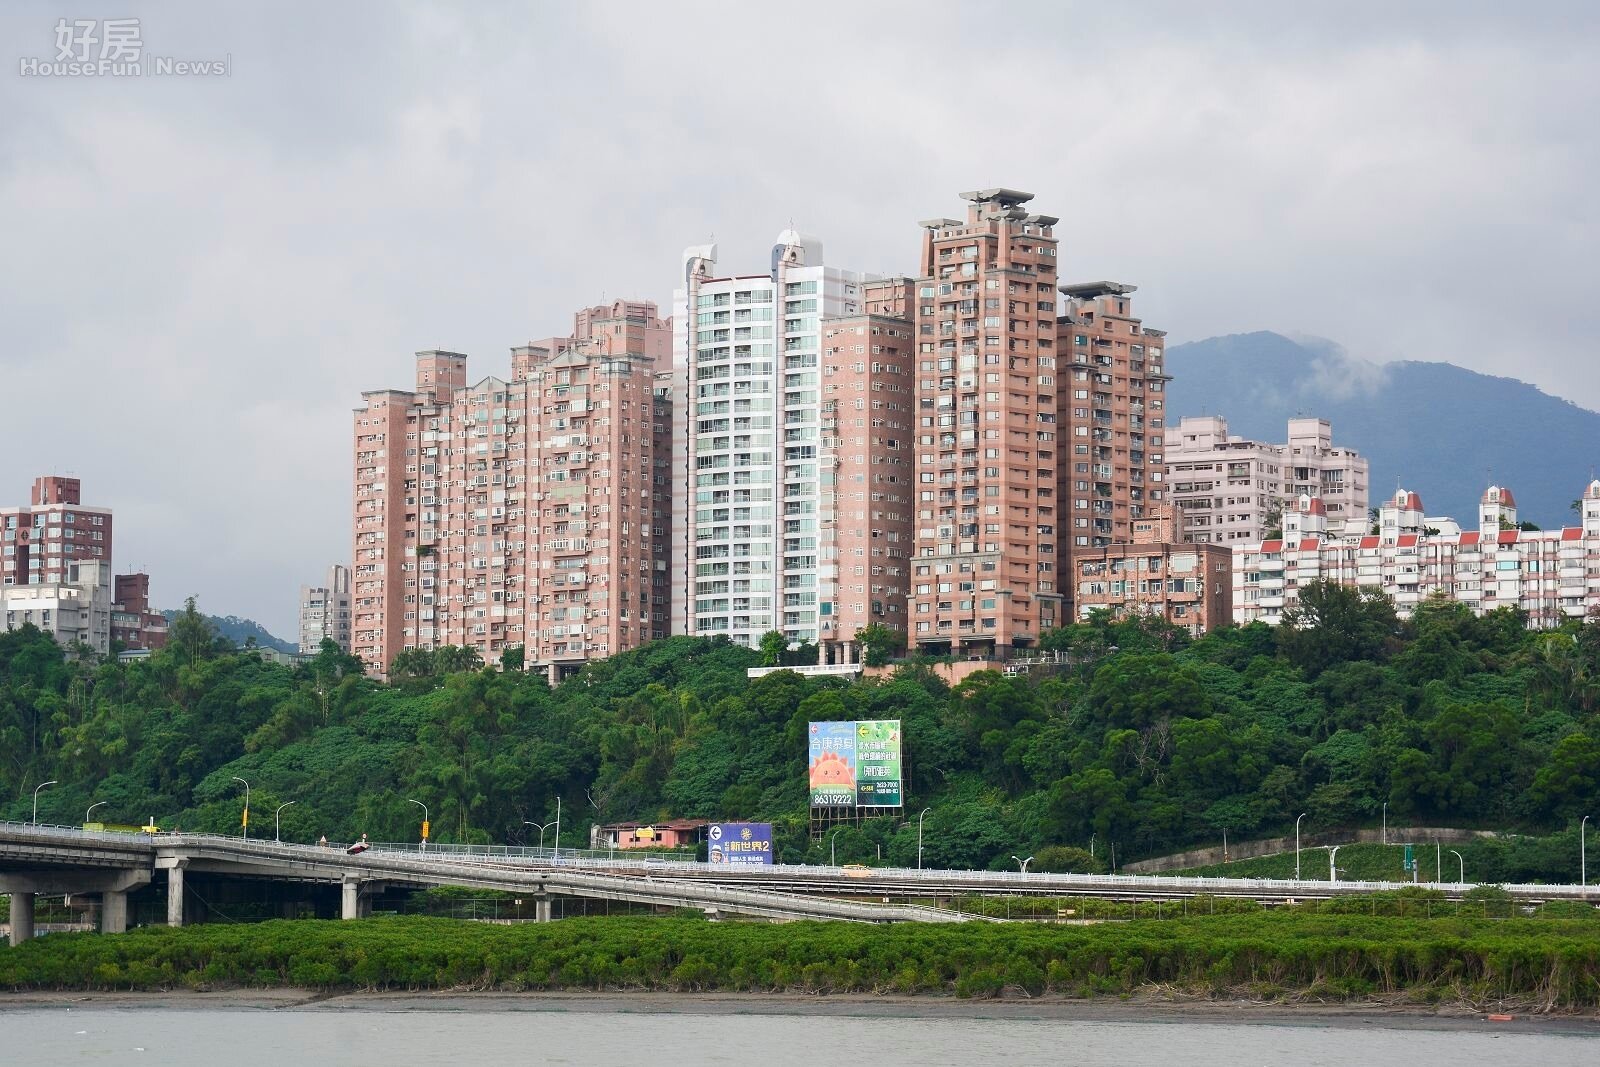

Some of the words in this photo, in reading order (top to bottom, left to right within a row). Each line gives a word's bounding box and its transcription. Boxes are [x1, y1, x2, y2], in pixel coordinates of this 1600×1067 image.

[814, 794, 852, 805] 86319222
[730, 841, 770, 852] 新世界2
